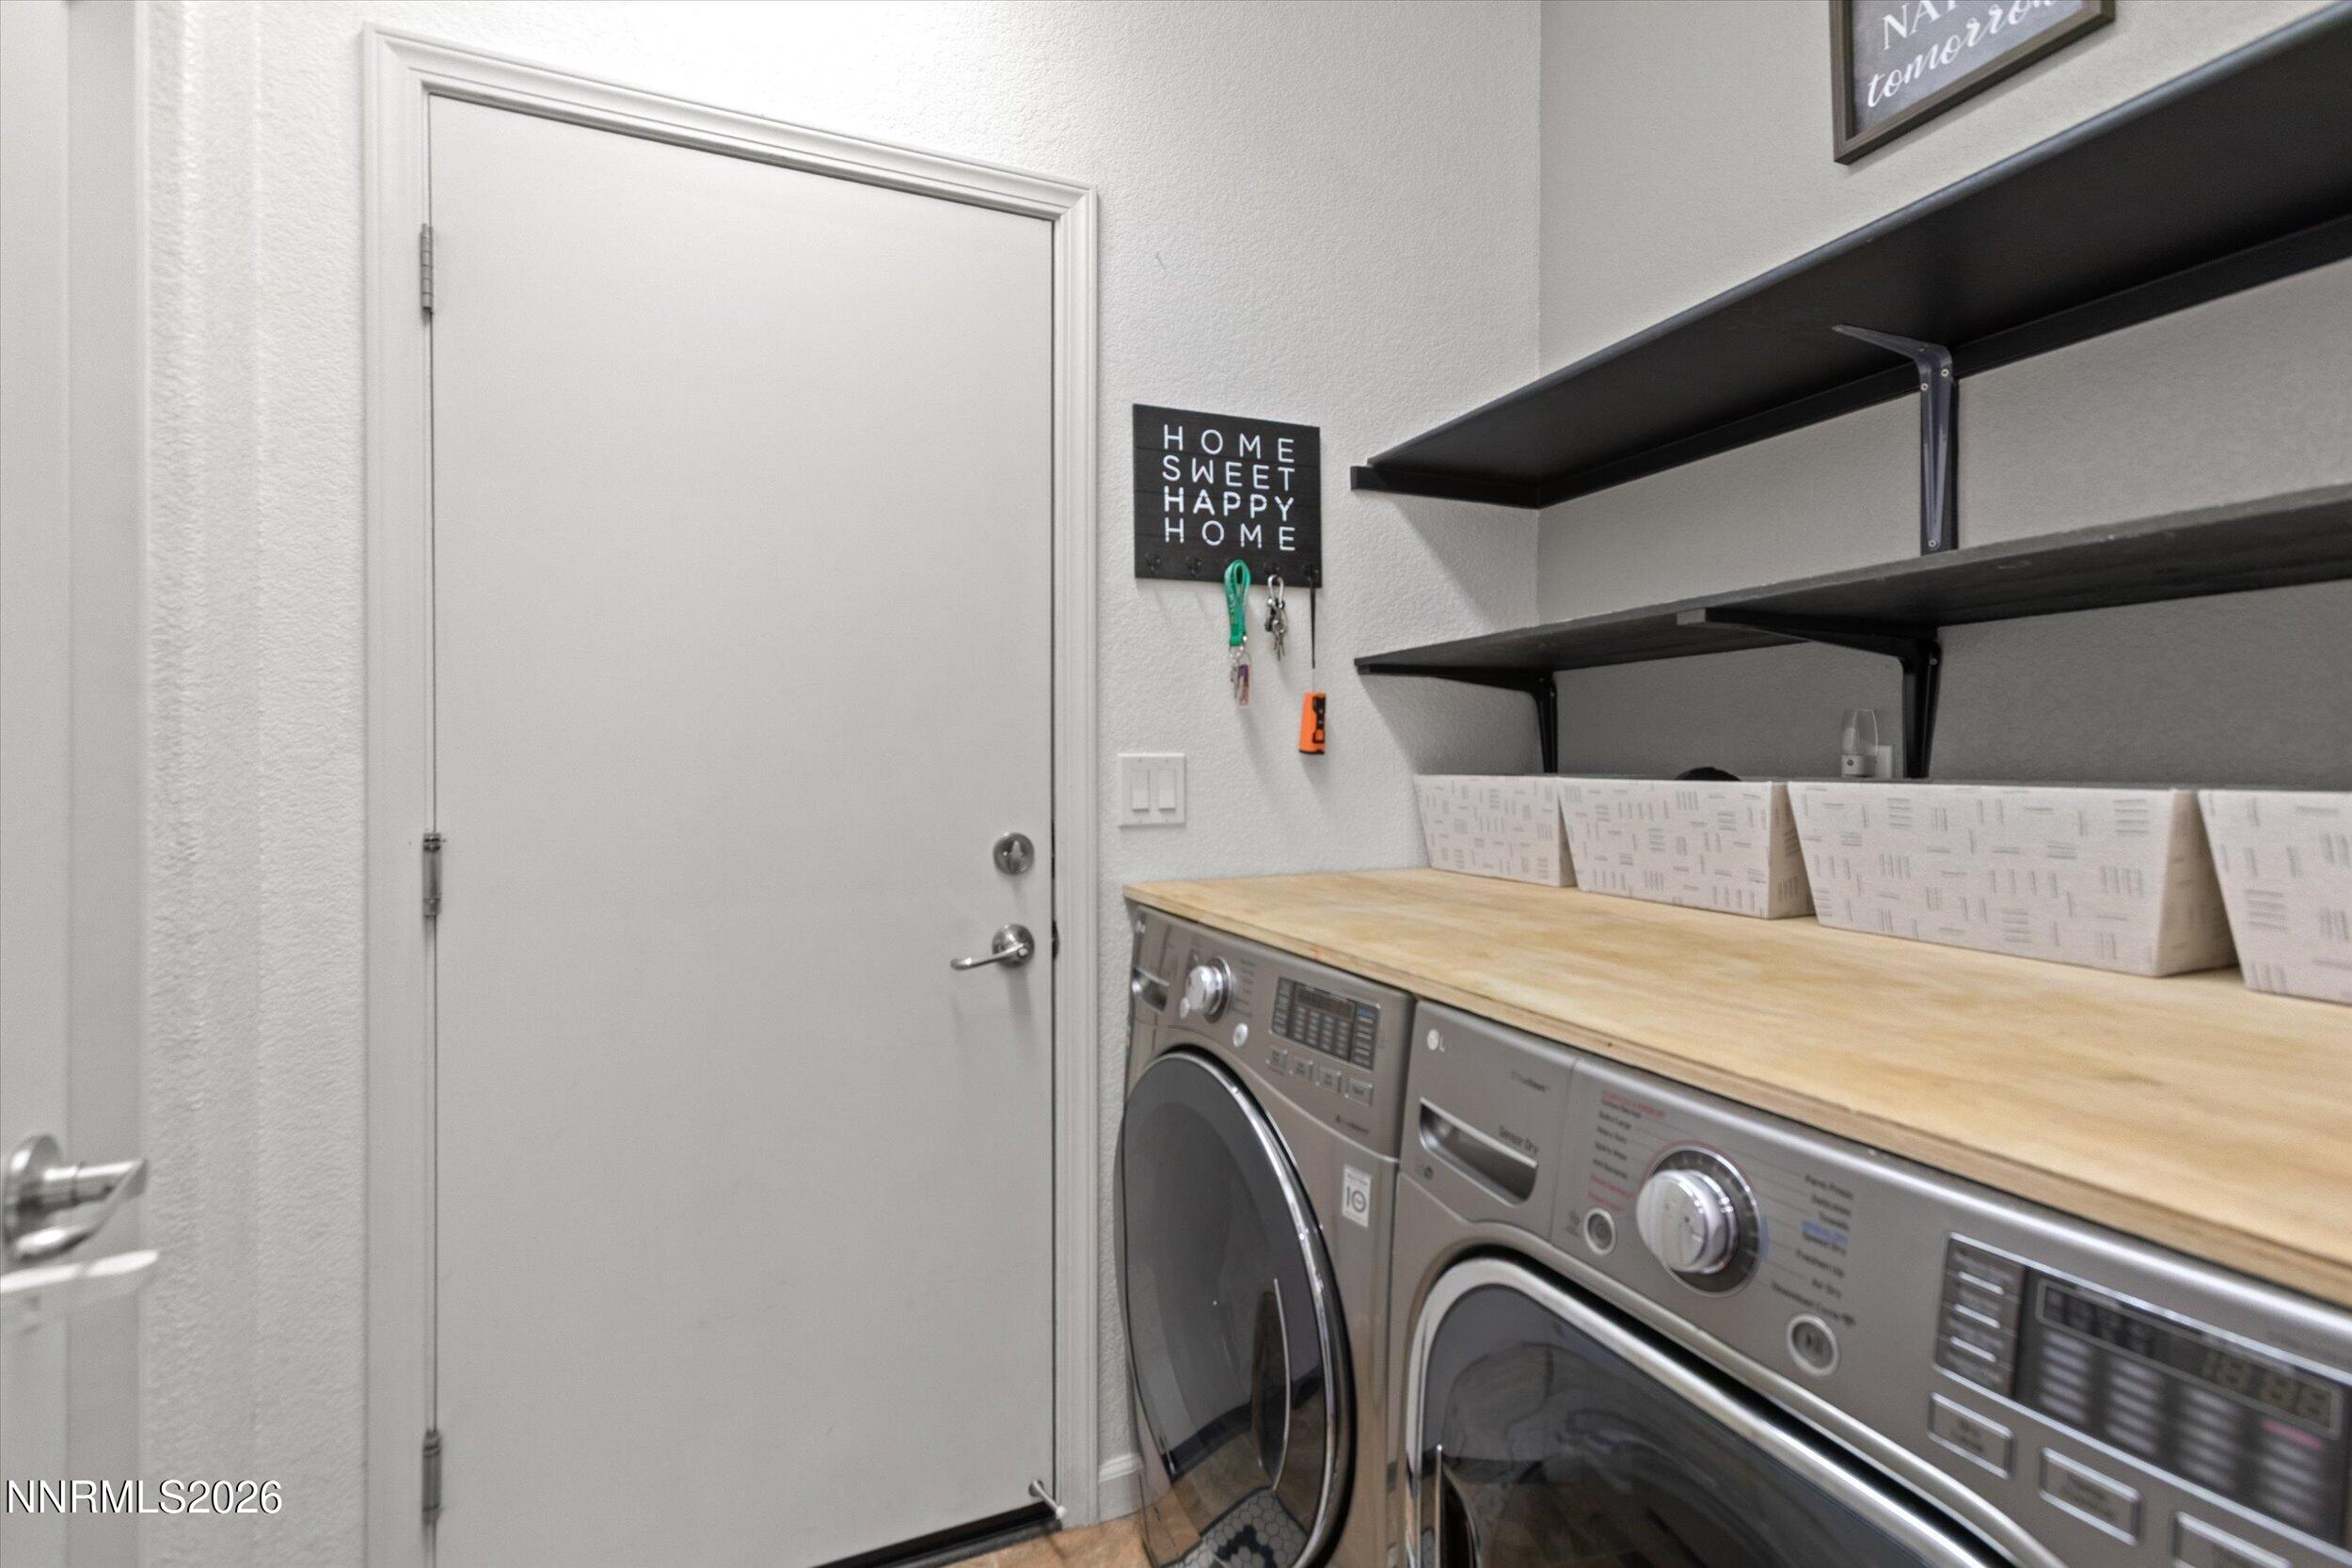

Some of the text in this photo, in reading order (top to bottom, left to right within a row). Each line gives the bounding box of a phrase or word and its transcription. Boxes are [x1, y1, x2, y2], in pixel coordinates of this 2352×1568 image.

[1882, 0, 1957, 51] NA
[1164, 423, 1295, 464] HOME
[1162, 454, 1295, 492] SWEET
[1164, 485, 1295, 522] HAPPY
[1164, 516, 1295, 551] HOME
